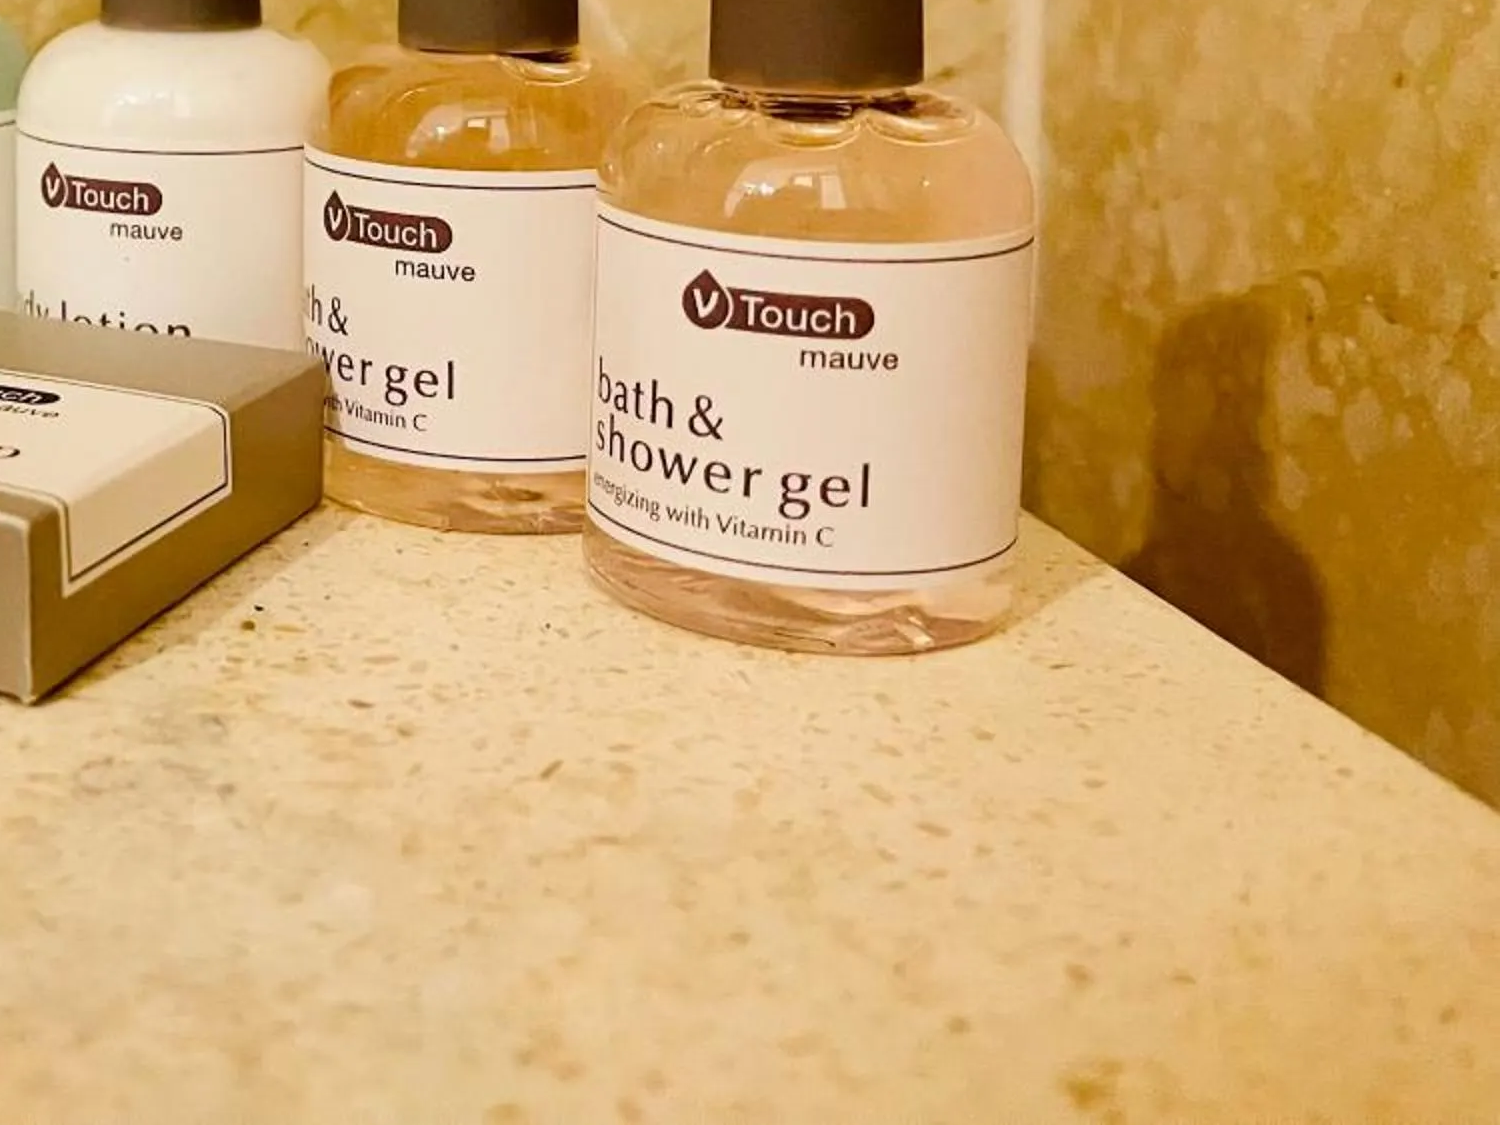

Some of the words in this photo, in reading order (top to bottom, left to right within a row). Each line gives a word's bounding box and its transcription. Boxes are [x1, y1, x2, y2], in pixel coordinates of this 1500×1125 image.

[71, 180, 150, 213] Touch
[109, 221, 184, 242] mauve
[354, 211, 438, 249] Touch
[394, 257, 476, 283] mauve
[327, 295, 349, 337] &
[739, 293, 857, 335] Touch
[798, 347, 900, 372] mauve
[385, 360, 455, 407] gel
[598, 355, 674, 430] bath
[687, 394, 725, 441] &
[345, 398, 406, 428] Vitamin
[413, 414, 428, 432] C
[595, 413, 764, 498] shower
[778, 461, 872, 522] gel
[593, 472, 661, 523] energizing
[665, 505, 710, 531] with
[716, 513, 808, 548] Vitamin
[814, 525, 836, 549] C
